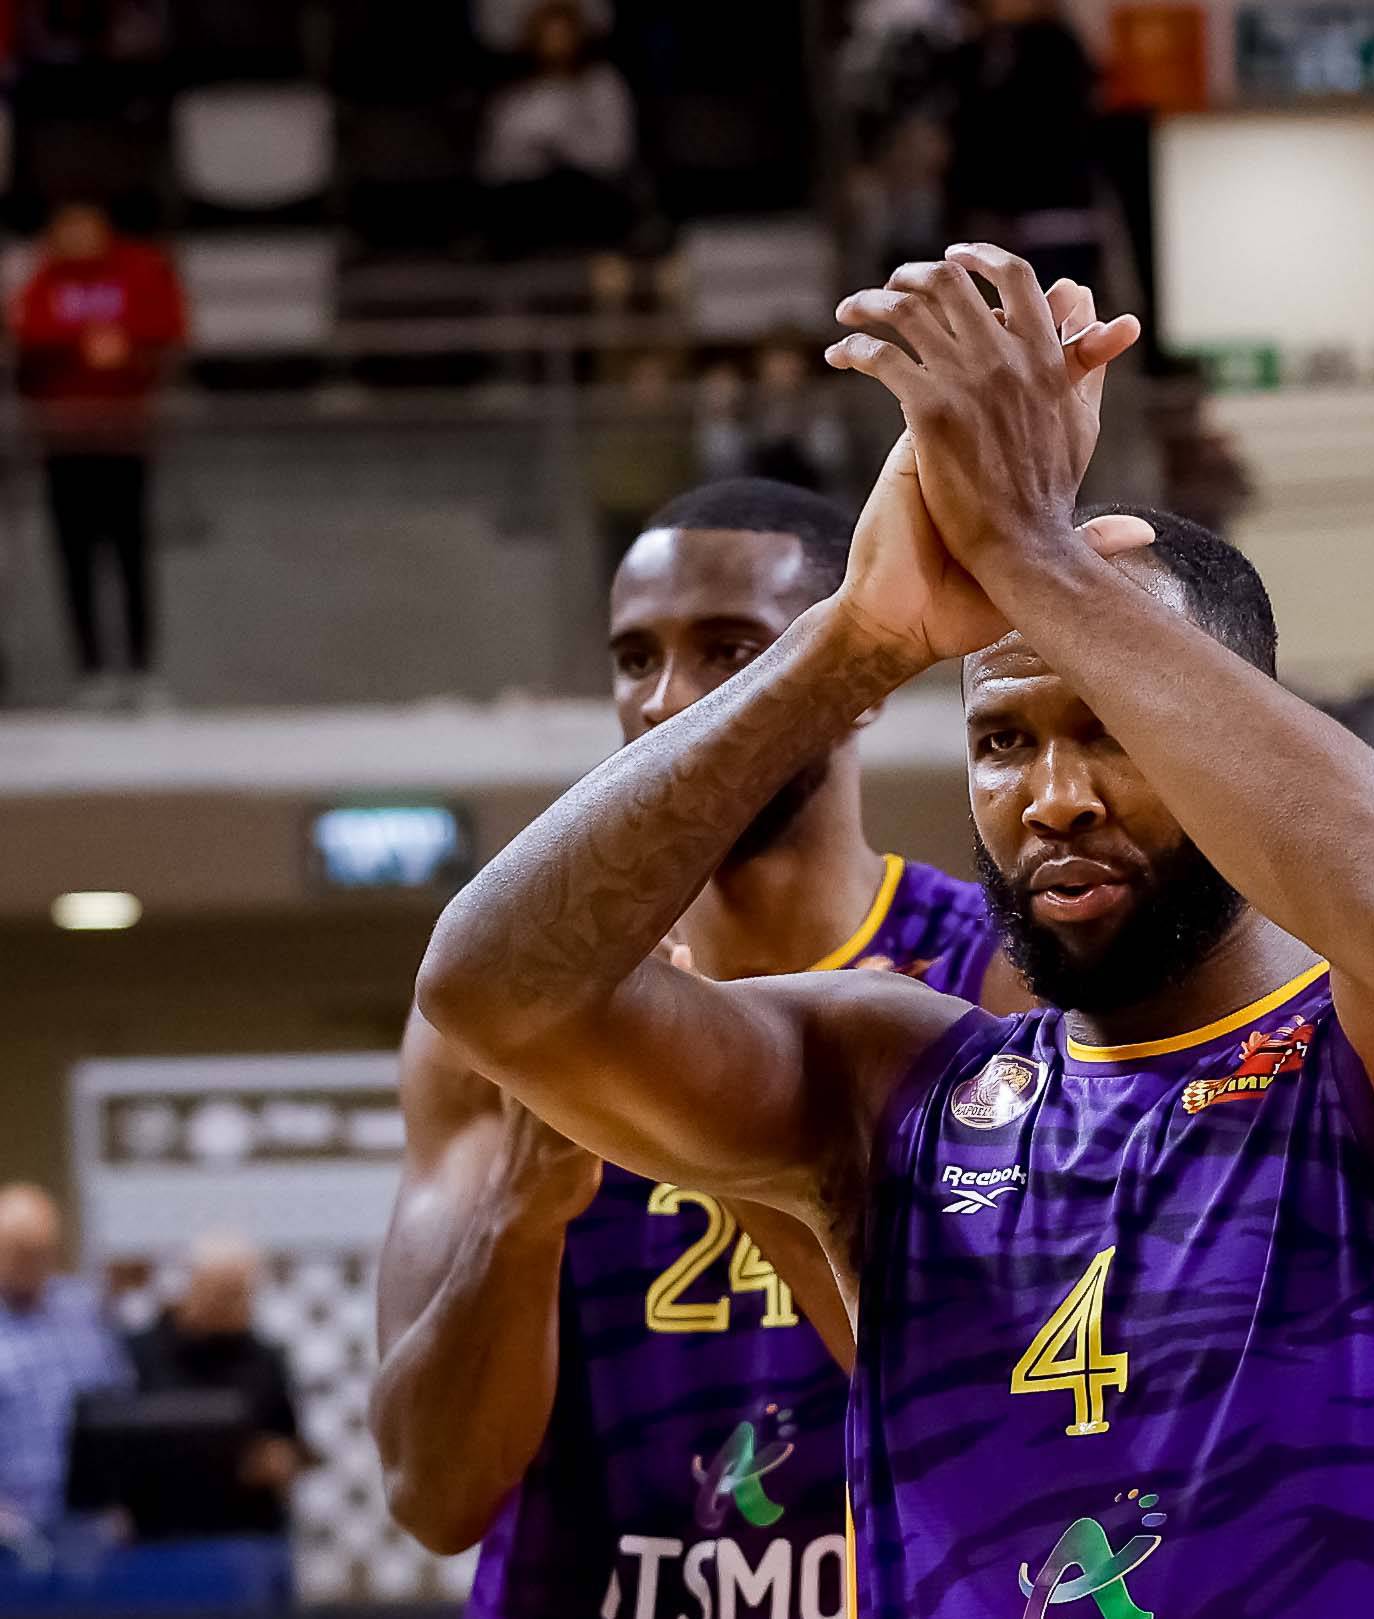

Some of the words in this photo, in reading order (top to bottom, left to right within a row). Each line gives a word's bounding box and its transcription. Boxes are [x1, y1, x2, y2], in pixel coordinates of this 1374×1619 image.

[942, 1165, 1027, 1187] Reebok
[645, 1183, 799, 1333] 24
[1010, 1246, 1129, 1436] 4
[601, 1534, 849, 1619] TSMO
